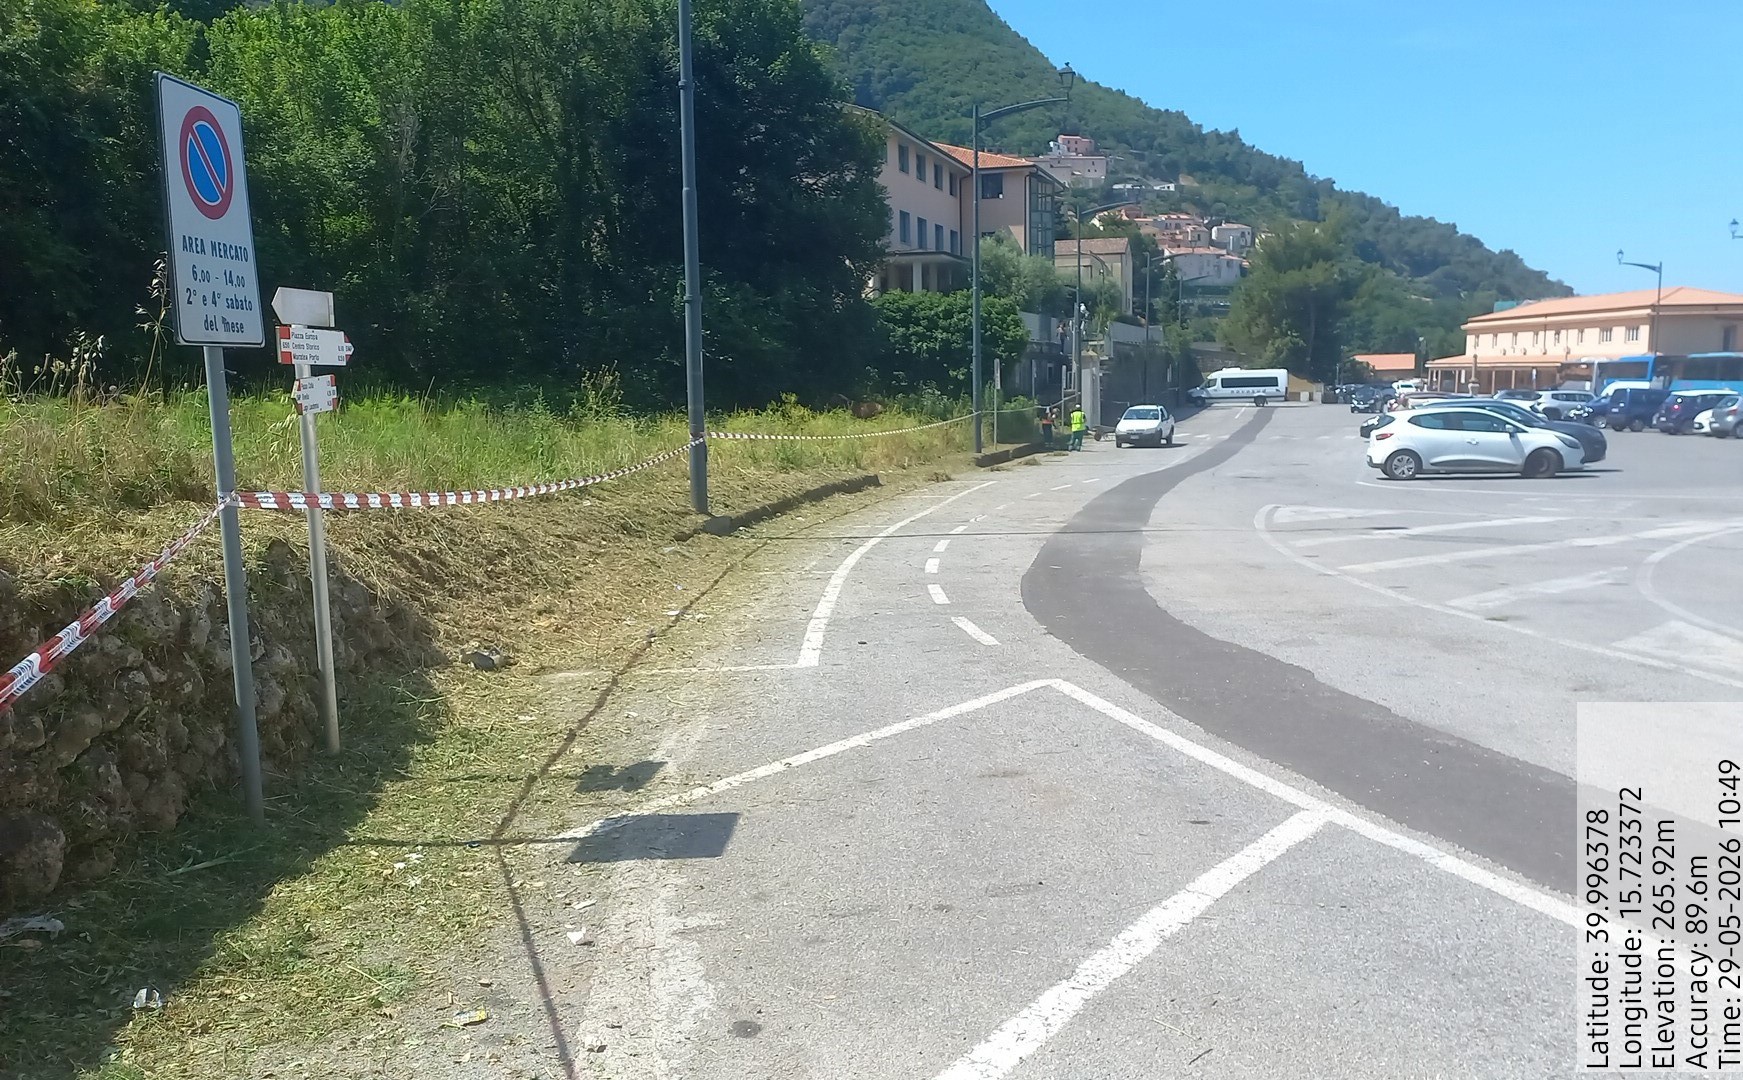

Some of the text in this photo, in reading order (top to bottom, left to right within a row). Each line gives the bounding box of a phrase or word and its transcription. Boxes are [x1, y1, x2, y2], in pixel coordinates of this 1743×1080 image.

[182, 234, 249, 262] AREA MERCATO
[202, 294, 207, 306] e
[225, 294, 253, 311] sabato
[203, 314, 244, 333] del mese
[292, 342, 305, 350] Centro
[306, 343, 320, 351] Storico
